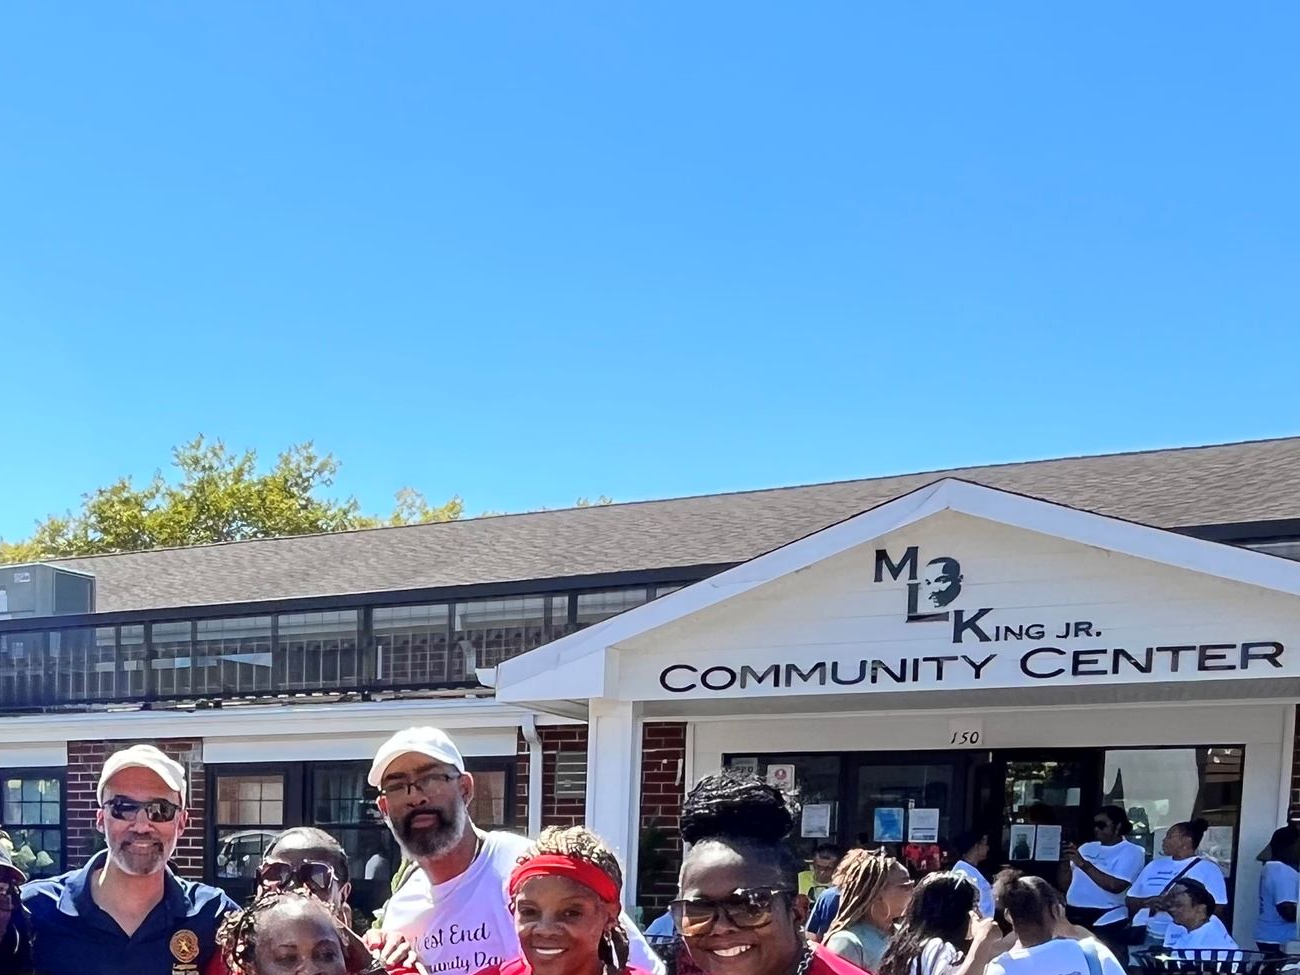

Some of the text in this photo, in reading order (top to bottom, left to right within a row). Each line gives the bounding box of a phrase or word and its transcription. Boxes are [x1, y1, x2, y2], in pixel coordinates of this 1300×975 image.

[1055, 621, 1102, 639] JR.
[659, 641, 1285, 693] COMMUNITY CENTER
[950, 731, 980, 745] 150
[450, 922, 491, 945] End
